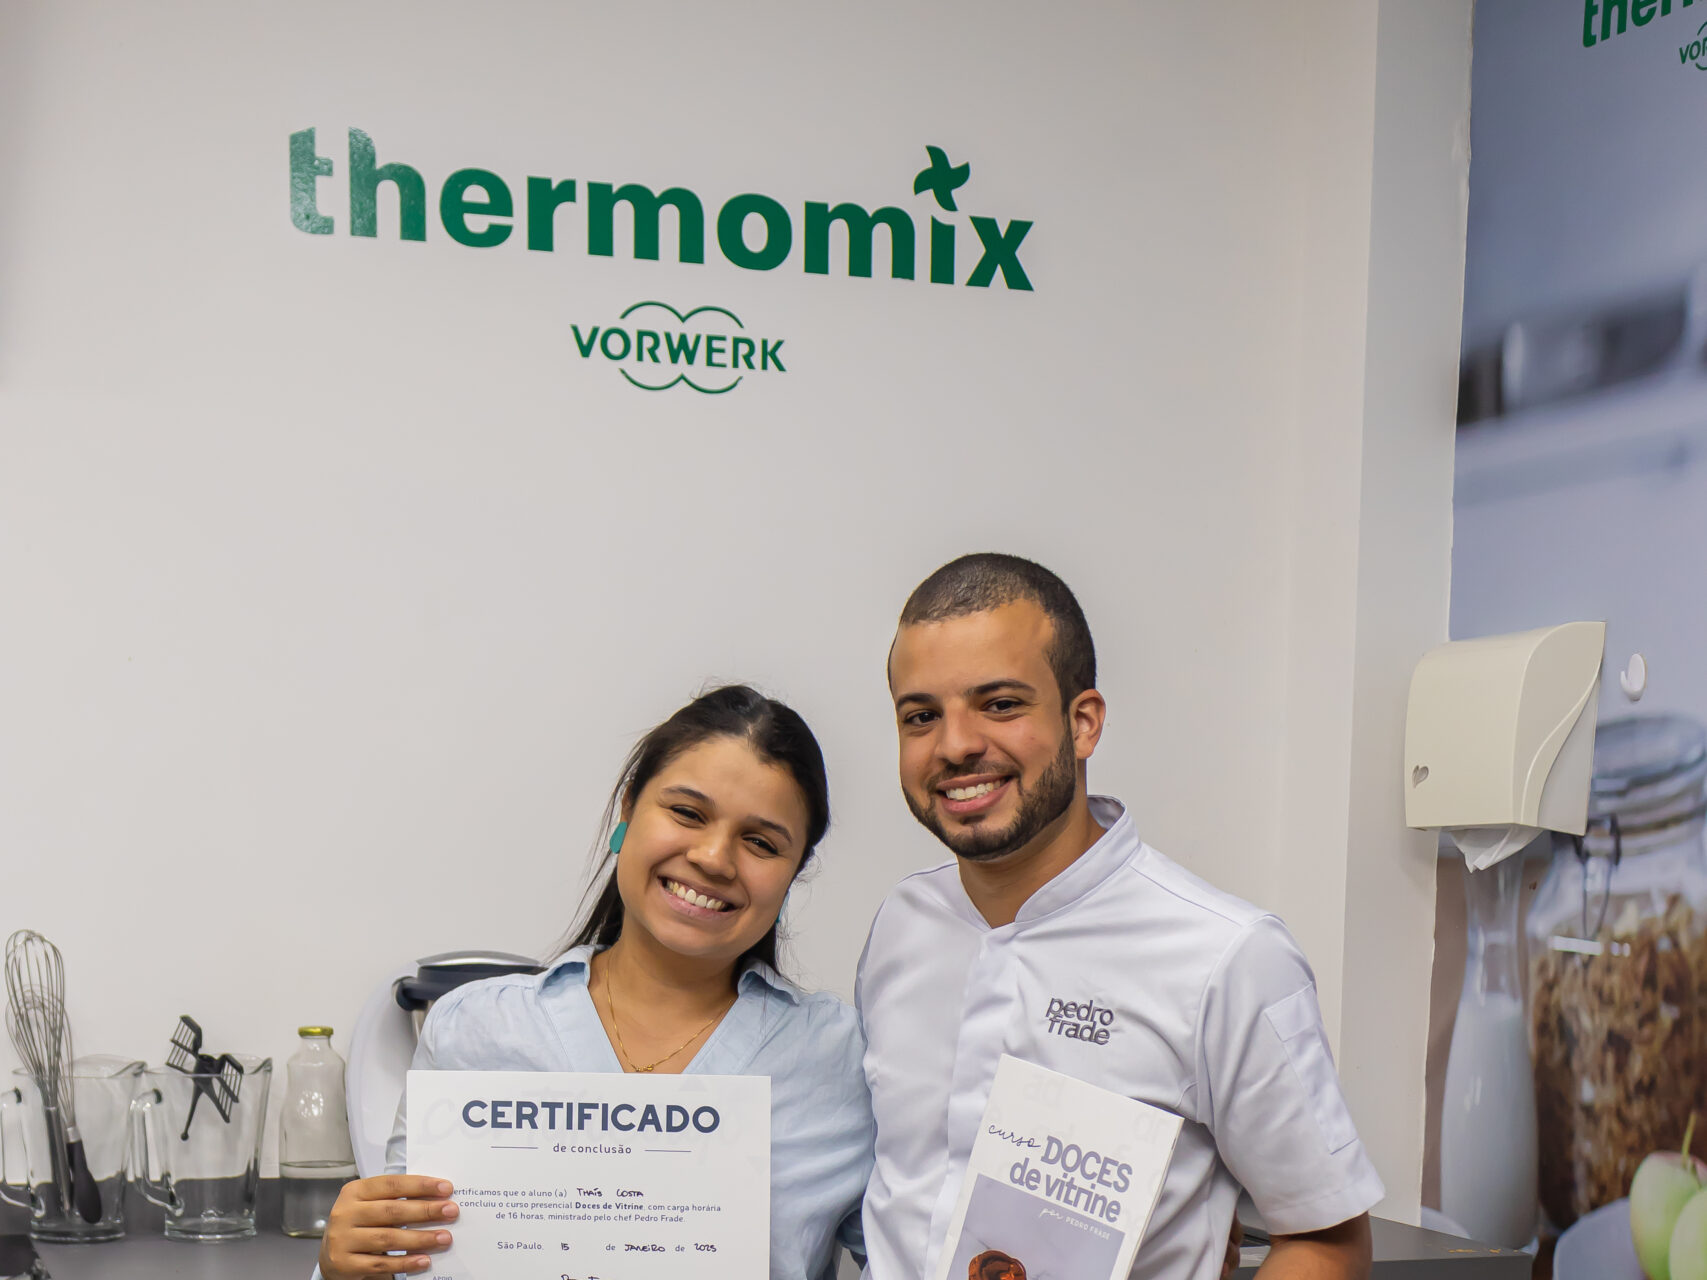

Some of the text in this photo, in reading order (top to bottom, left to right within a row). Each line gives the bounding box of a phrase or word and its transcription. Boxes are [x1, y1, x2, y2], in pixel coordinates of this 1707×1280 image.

[288, 126, 1035, 293] thermomix
[570, 323, 786, 373] VORWERK
[1045, 997, 1114, 1027] pedro
[1047, 1013, 1110, 1046] frade
[461, 1099, 721, 1134] CERTIFICADO
[552, 1143, 632, 1154] de conclusão
[988, 1124, 1134, 1194] curso DOCES
[453, 1187, 501, 1197] ertificamos
[502, 1189, 519, 1198] que
[528, 1189, 553, 1198] aluno
[554, 1189, 567, 1199] (a)
[616, 1188, 644, 1198] COSTA
[1009, 1157, 1122, 1223] de vitrine
[459, 1199, 496, 1208] concluiu
[530, 1201, 573, 1210] presencial
[575, 1202, 600, 1210] Doces
[602, 1202, 613, 1210] de
[666, 1205, 690, 1214] carga
[691, 1203, 722, 1212] horária
[495, 1211, 507, 1219] de
[547, 1212, 592, 1221] ministrado
[593, 1213, 612, 1222] pelo
[613, 1213, 632, 1222] chef
[634, 1214, 659, 1222] Pedro
[497, 1241, 515, 1250] São
[560, 1242, 570, 1251] 15
[605, 1243, 616, 1251] de
[694, 1242, 717, 1253] 2025
